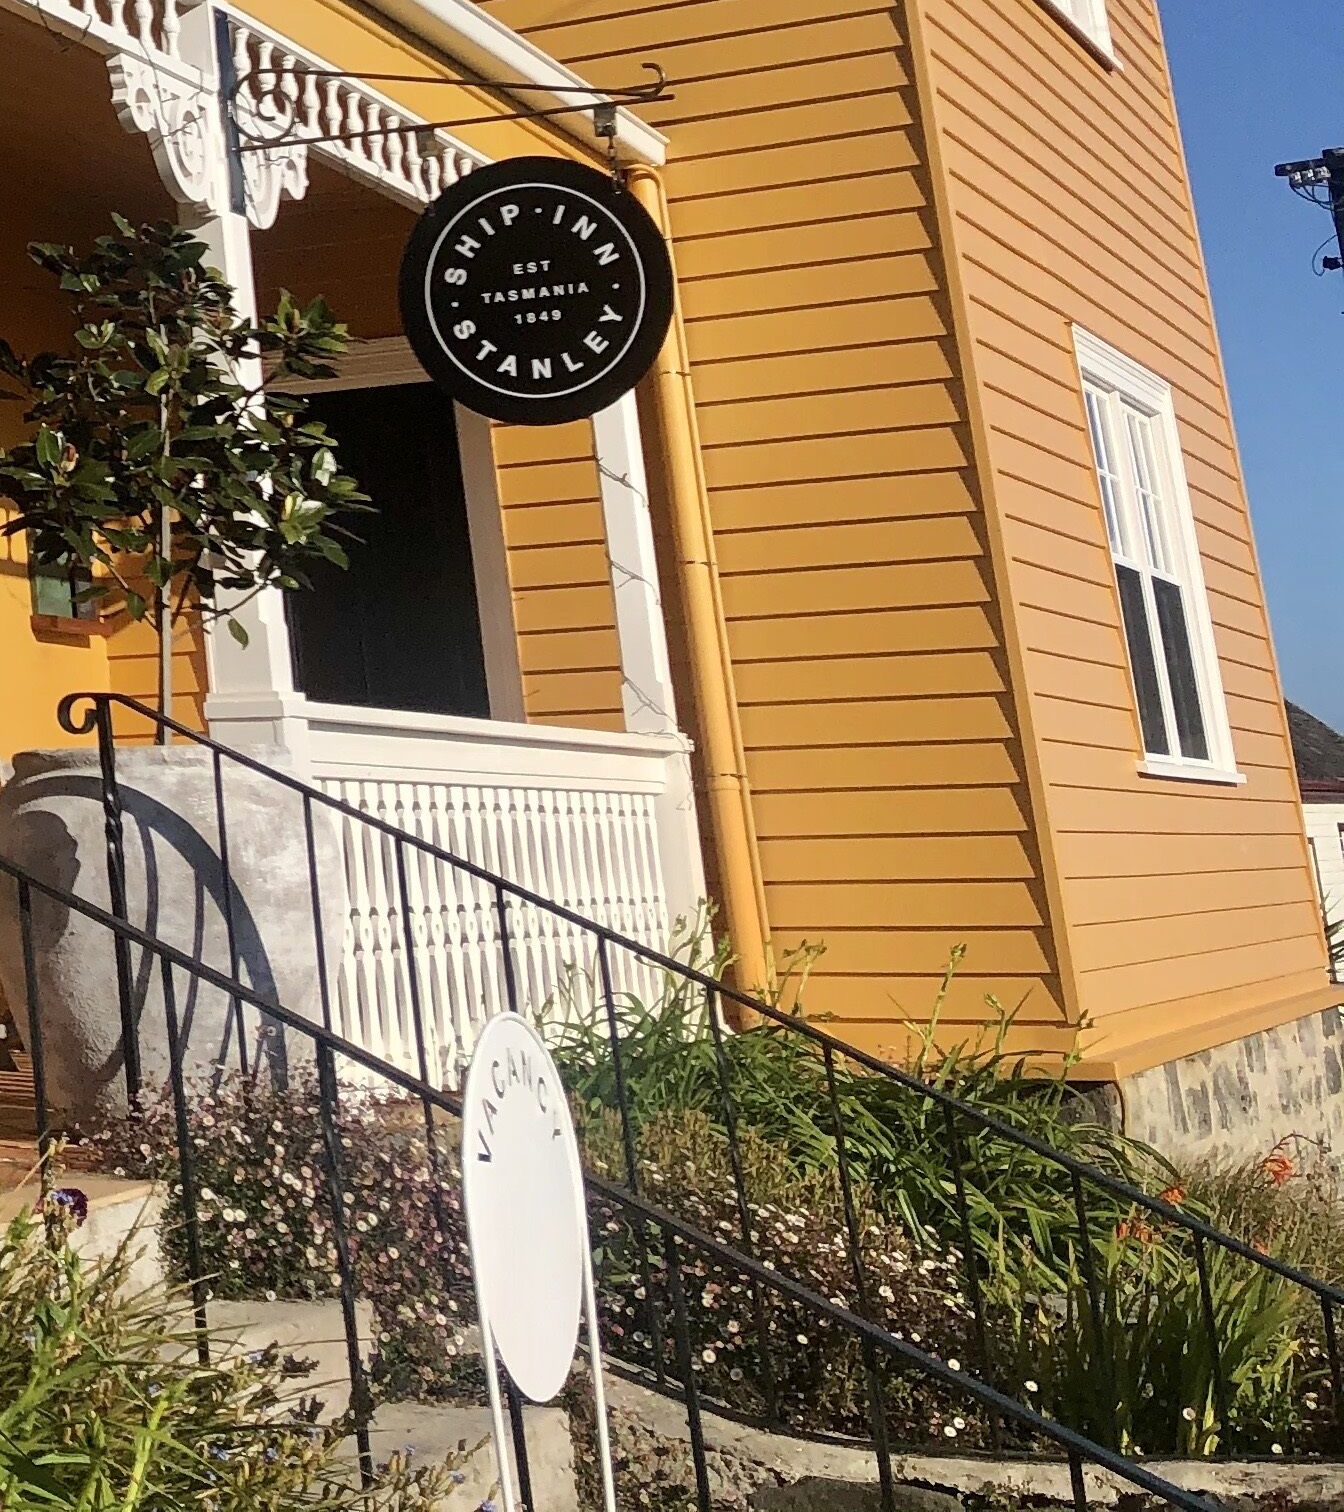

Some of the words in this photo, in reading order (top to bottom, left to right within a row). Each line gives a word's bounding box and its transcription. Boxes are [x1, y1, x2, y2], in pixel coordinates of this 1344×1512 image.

[444, 204, 520, 285] SHIP
[552, 204, 620, 266] INN
[512, 260, 551, 275] EST
[481, 282, 590, 303] TASMANIA
[514, 310, 562, 324] 1849
[452, 304, 623, 380] STANLEY
